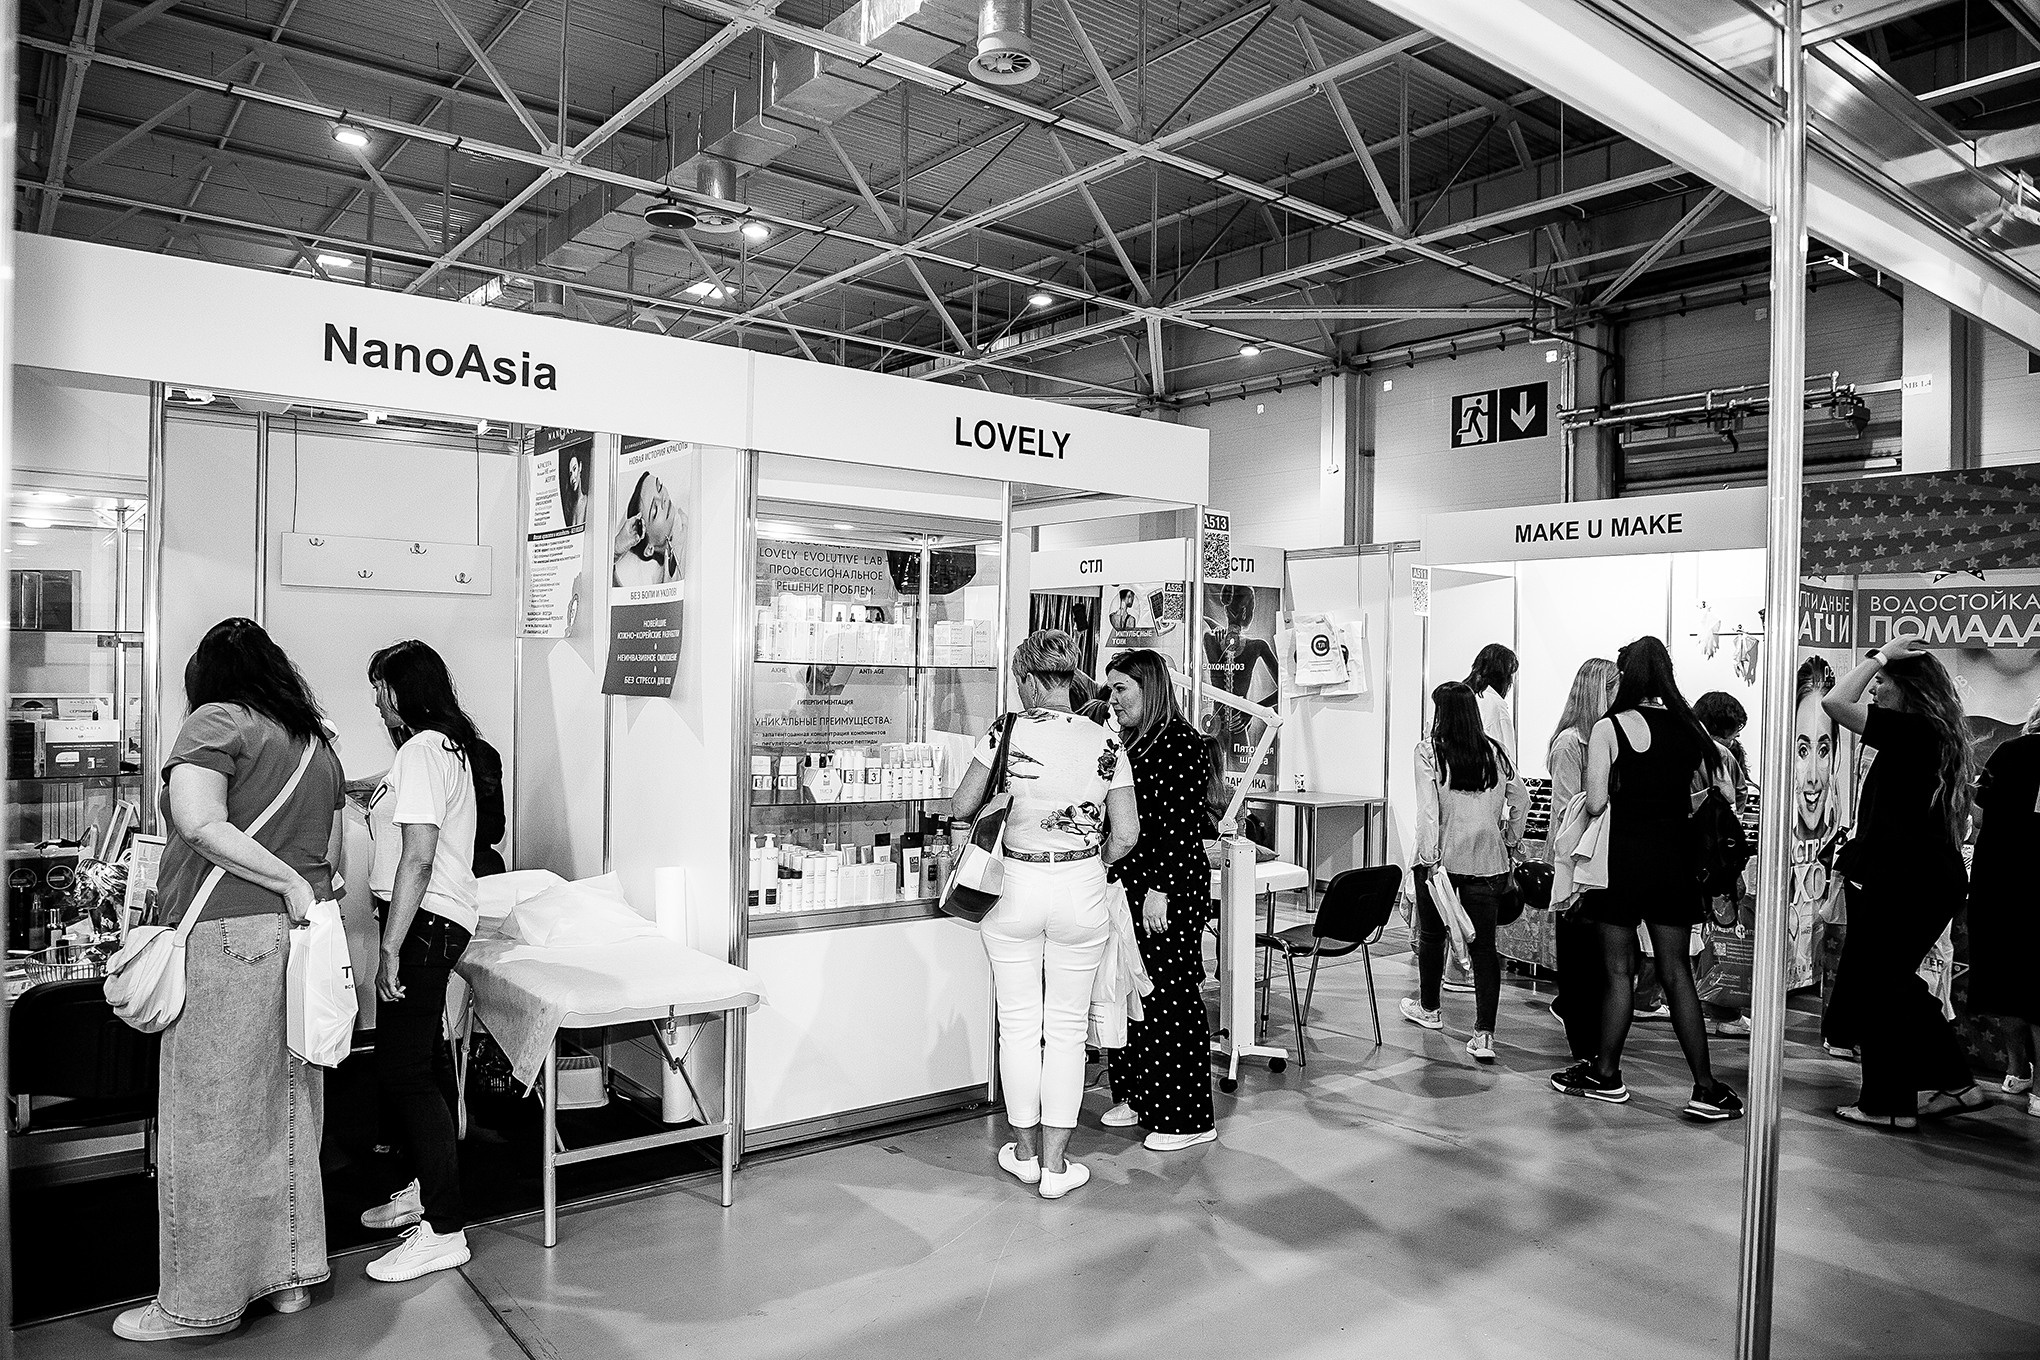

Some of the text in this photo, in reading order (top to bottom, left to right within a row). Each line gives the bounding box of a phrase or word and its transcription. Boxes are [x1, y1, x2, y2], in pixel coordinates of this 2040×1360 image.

[323, 322, 558, 391] NanoAsia
[955, 416, 1071, 460] LOVELY
[1515, 512, 1683, 543] MAKE U MAKE
[759, 547, 883, 566] LOVELY EVOLUTIVE LAB
[769, 564, 884, 581] ПРОФЕССИОНАЛЬНОЕ
[1079, 559, 1103, 574] СТЛ
[1230, 557, 1255, 573] СТЛ
[776, 581, 876, 596] РЕШЕНИЕ ПРОБЛЕМ:
[1166, 583, 1183, 592] A525
[630, 591, 641, 600] БЕЗ
[1799, 591, 1850, 612] ПТИДНЫЕ
[1799, 610, 1850, 643] АТЧИ
[1202, 662, 1245, 673] еохондроз
[624, 676, 635, 684] БЕЗ
[635, 676, 656, 684] СТРЕССА
[755, 716, 893, 727] УНИКАЛЬНЫЕ ПРЕИМУЩЕСТВА:
[1233, 743, 1275, 755] Пятоая
[1239, 756, 1269, 766] шпа
